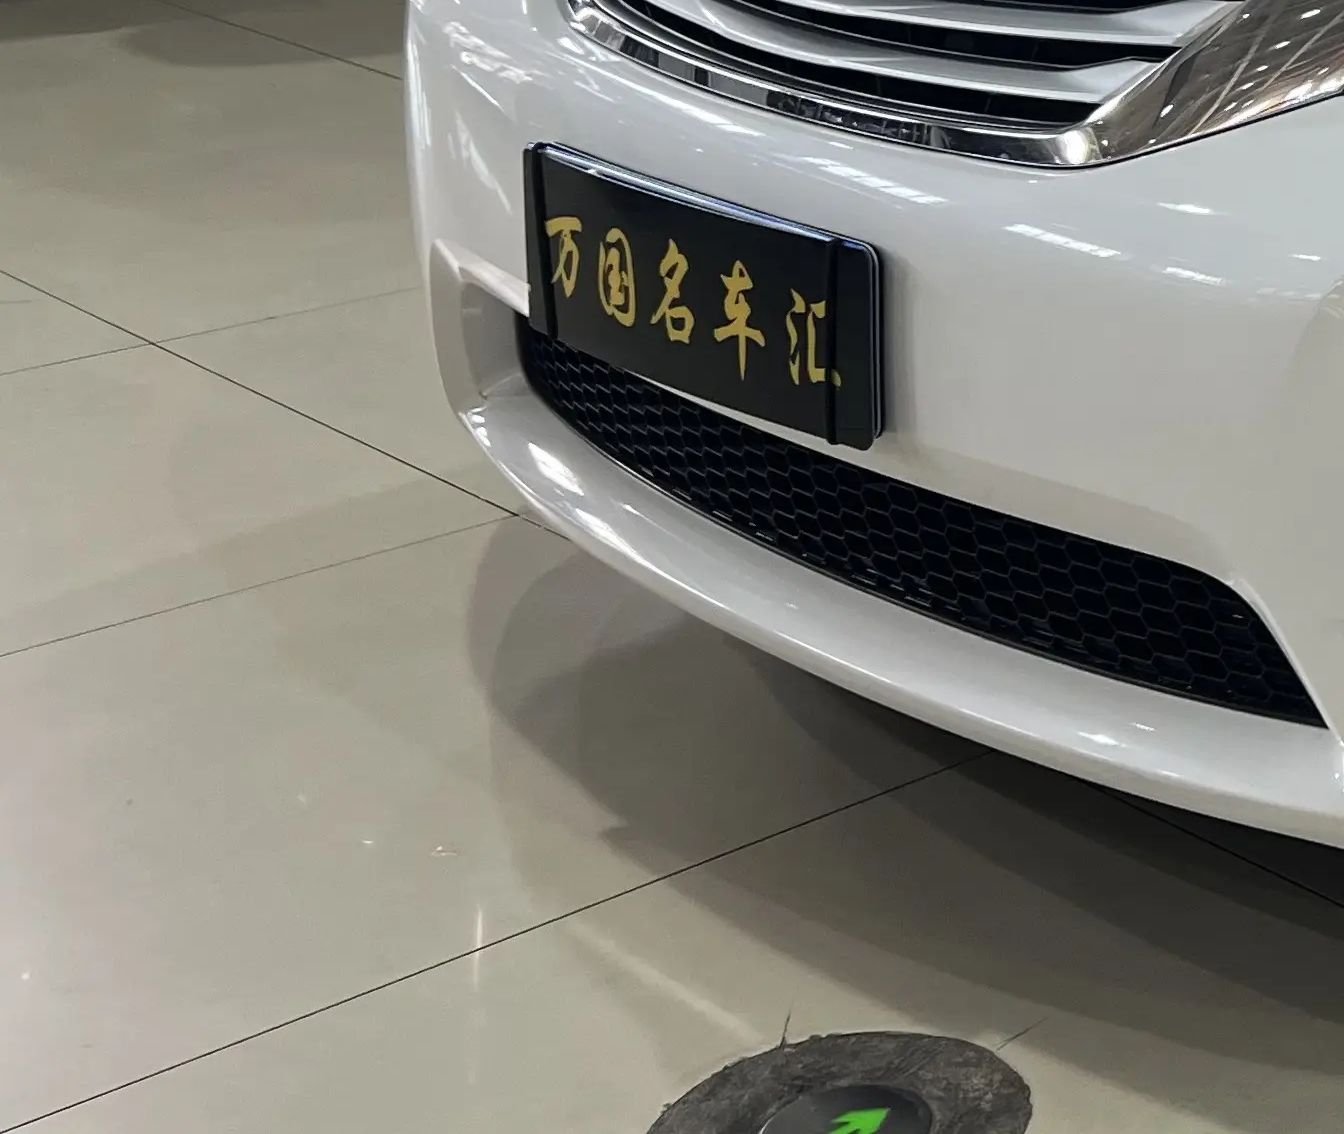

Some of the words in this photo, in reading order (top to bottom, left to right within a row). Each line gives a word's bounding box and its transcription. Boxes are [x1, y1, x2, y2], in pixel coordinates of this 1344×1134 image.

[545, 216, 841, 387] 万国名车汇
